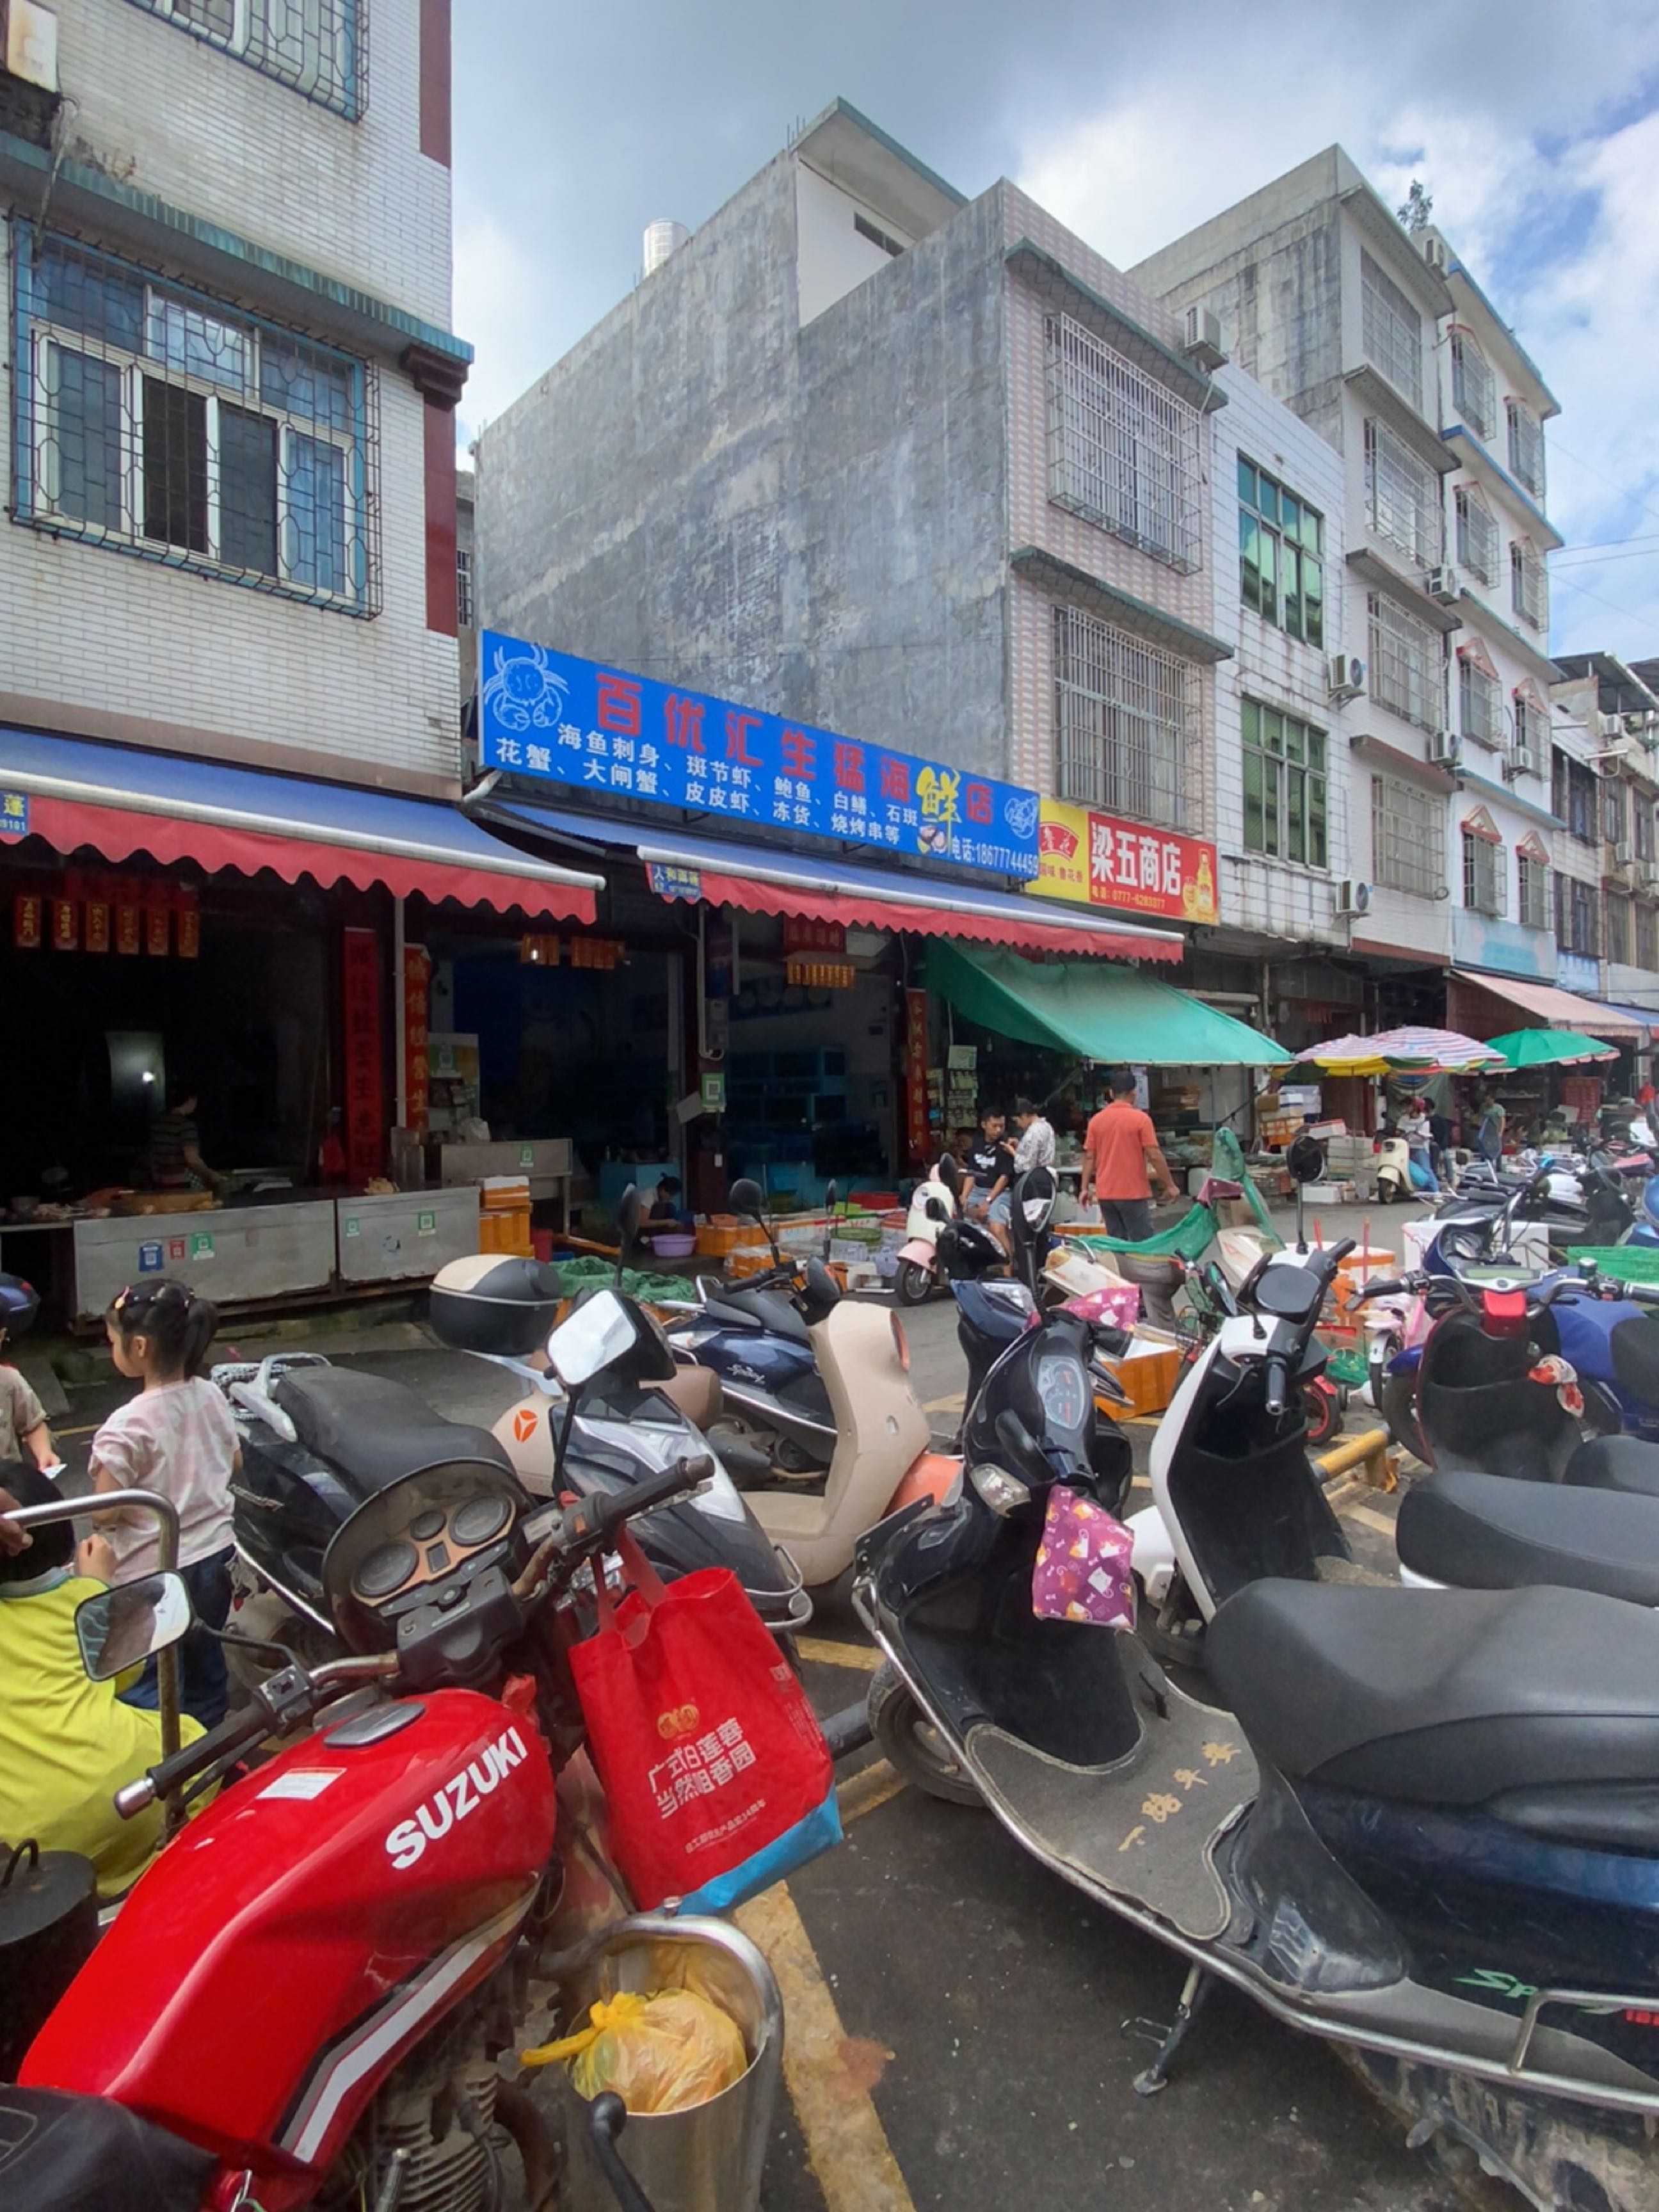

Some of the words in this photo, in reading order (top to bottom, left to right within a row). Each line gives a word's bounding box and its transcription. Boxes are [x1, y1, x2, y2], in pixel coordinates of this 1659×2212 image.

[597, 672, 994, 856] 百优汇生猛海鲜店
[1091, 821, 1181, 895] 梁五商店
[386, 1726, 529, 1870] SUZUKI
